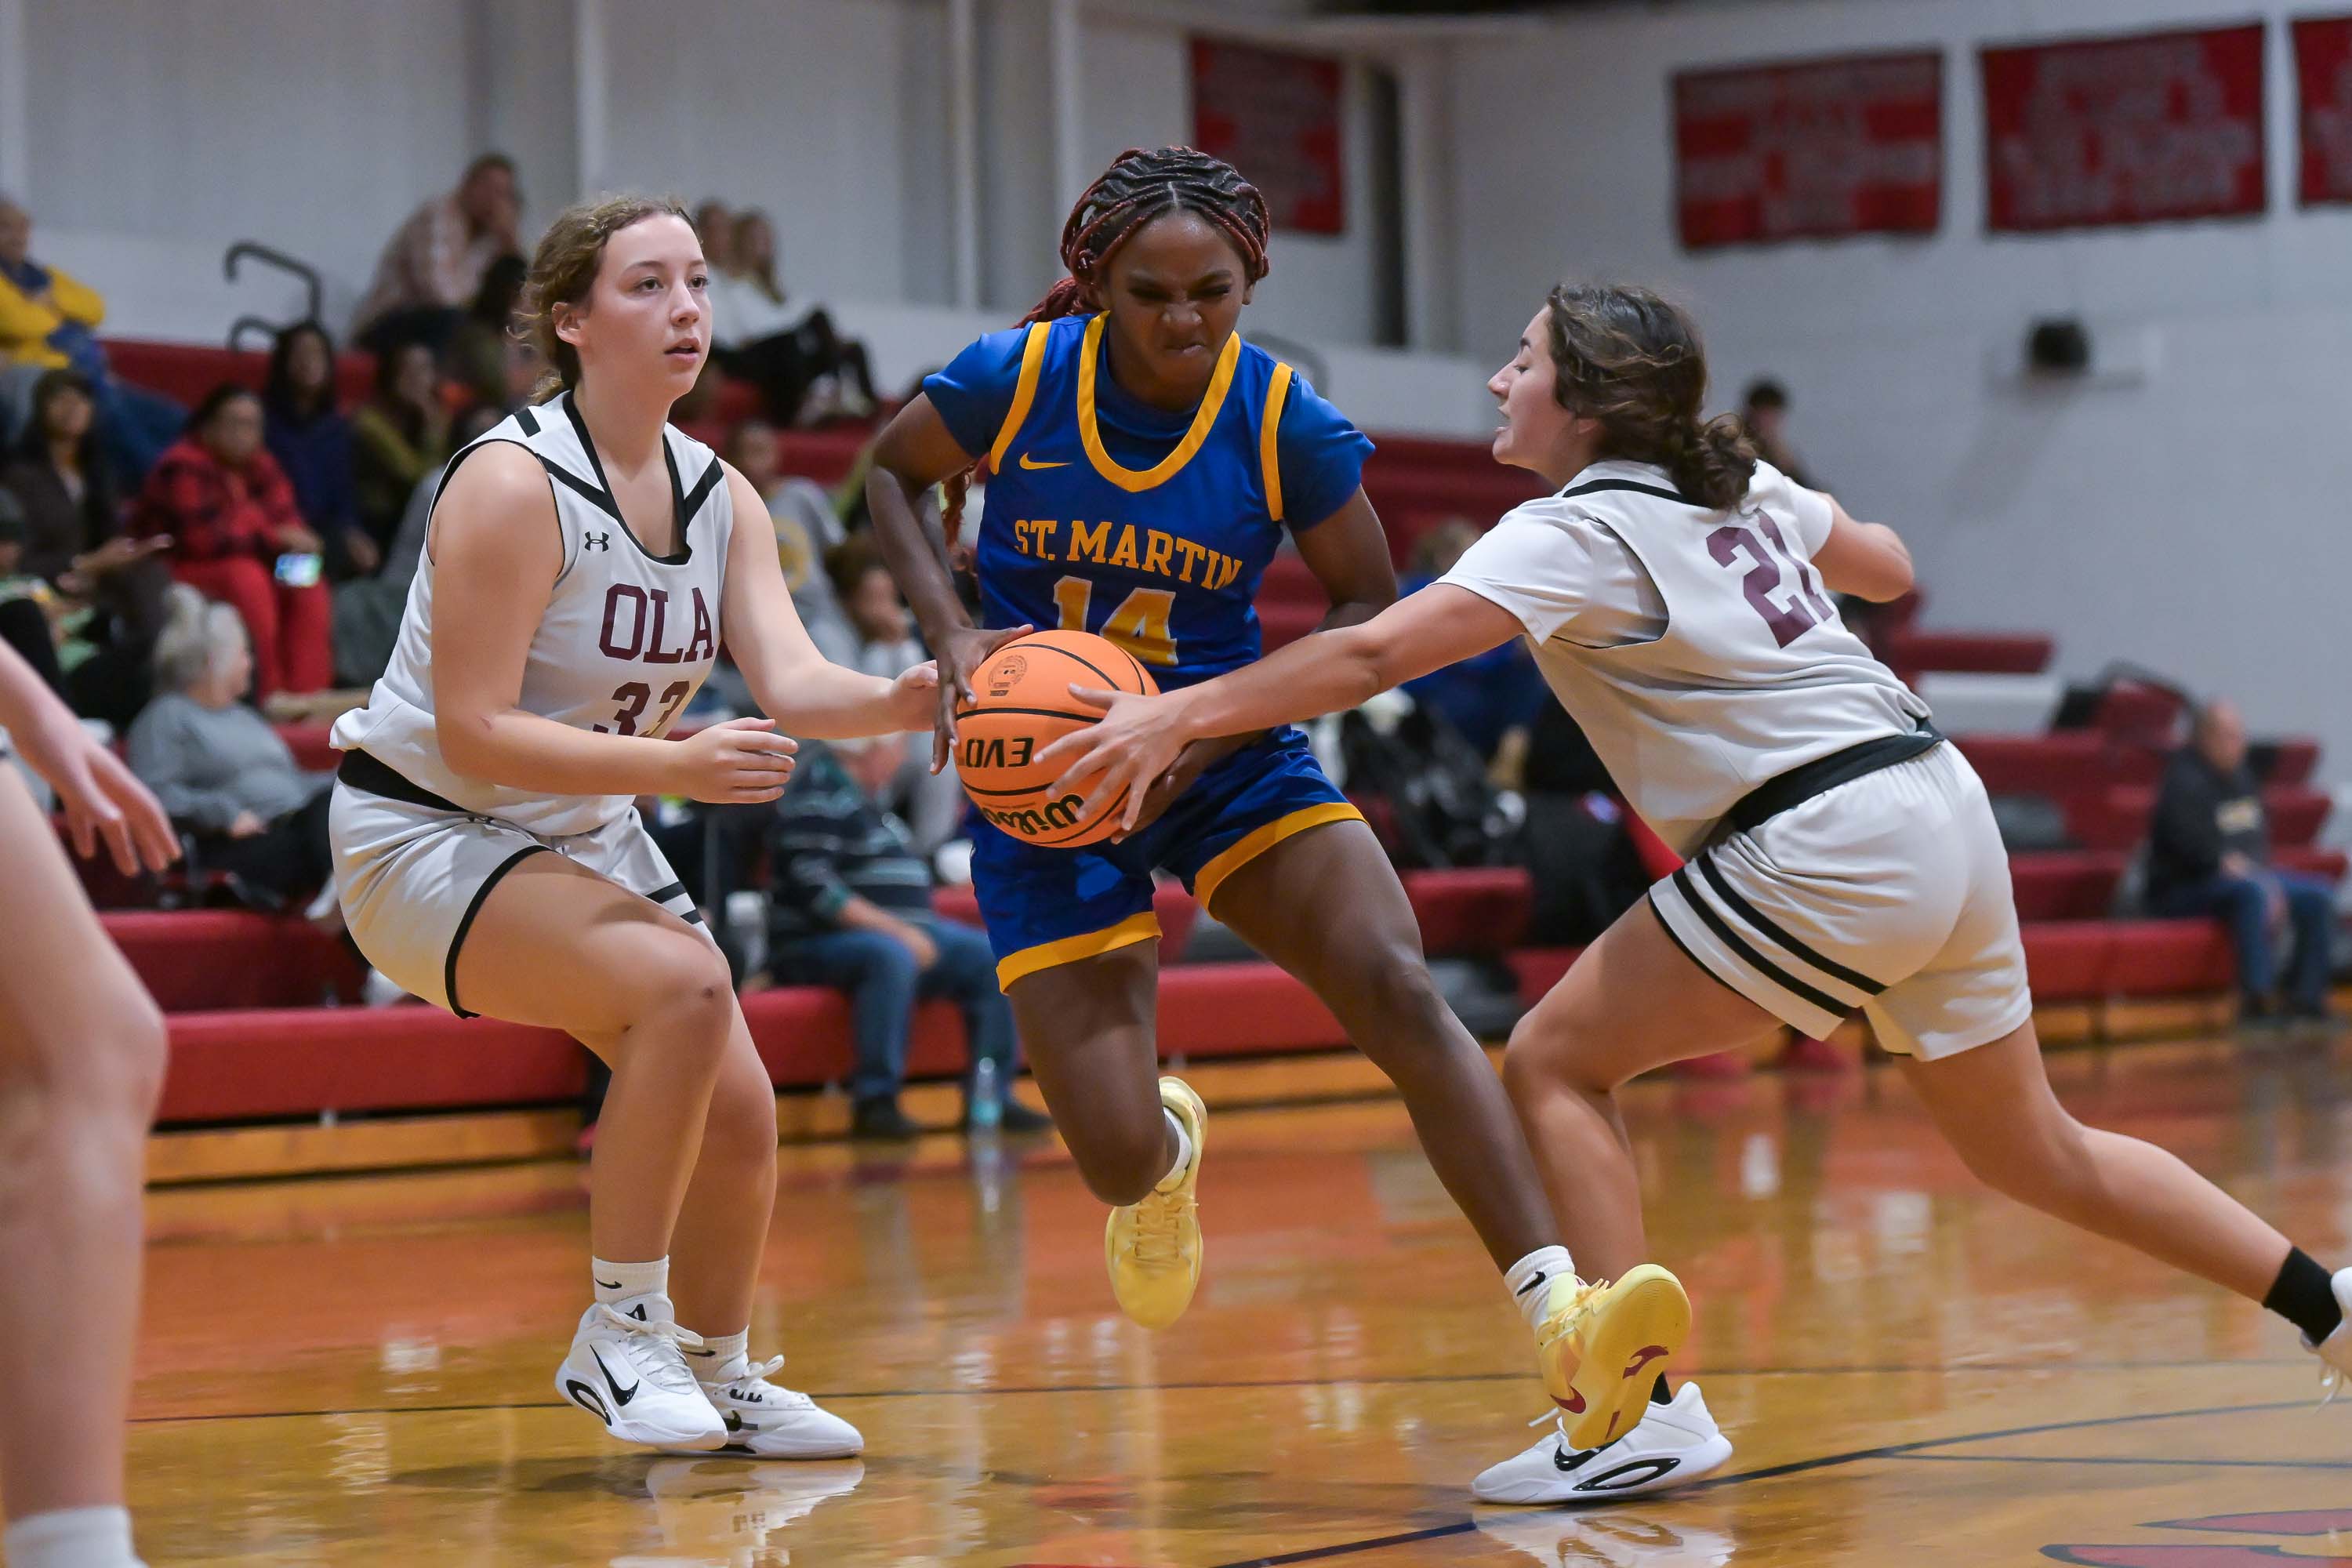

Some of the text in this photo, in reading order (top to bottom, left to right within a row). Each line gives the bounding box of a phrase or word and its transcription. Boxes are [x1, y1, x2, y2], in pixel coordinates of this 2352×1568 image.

[1014, 519, 1243, 590] ST. MARTIN
[1705, 507, 1835, 649] 21
[598, 583, 714, 664] OLA
[1052, 575, 1179, 666] 14
[965, 737, 1035, 768] EVO
[981, 793, 1084, 837] Wilso
